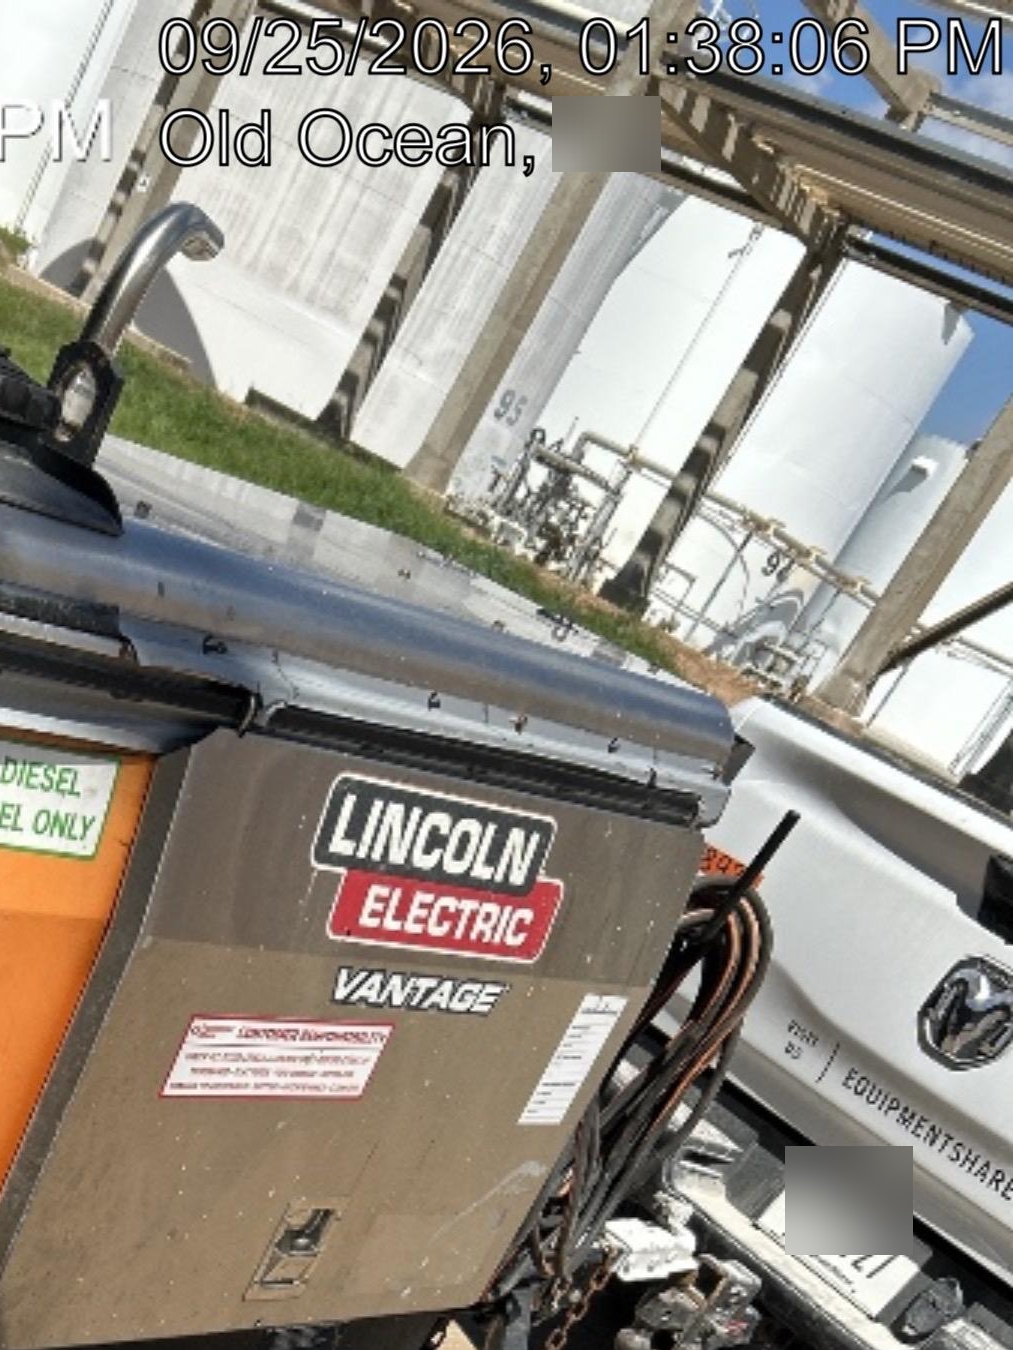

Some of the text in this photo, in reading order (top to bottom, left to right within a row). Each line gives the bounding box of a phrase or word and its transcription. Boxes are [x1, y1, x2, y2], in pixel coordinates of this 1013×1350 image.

[0, 756, 81, 797] DIESEL
[31, 809, 96, 842] ONLY
[329, 793, 540, 886] LINCOLN
[359, 884, 535, 947] ELECTRIC
[333, 967, 506, 1014] VANTAGE
[842, 1067, 1013, 1201] EQUIPMENTSHARE
